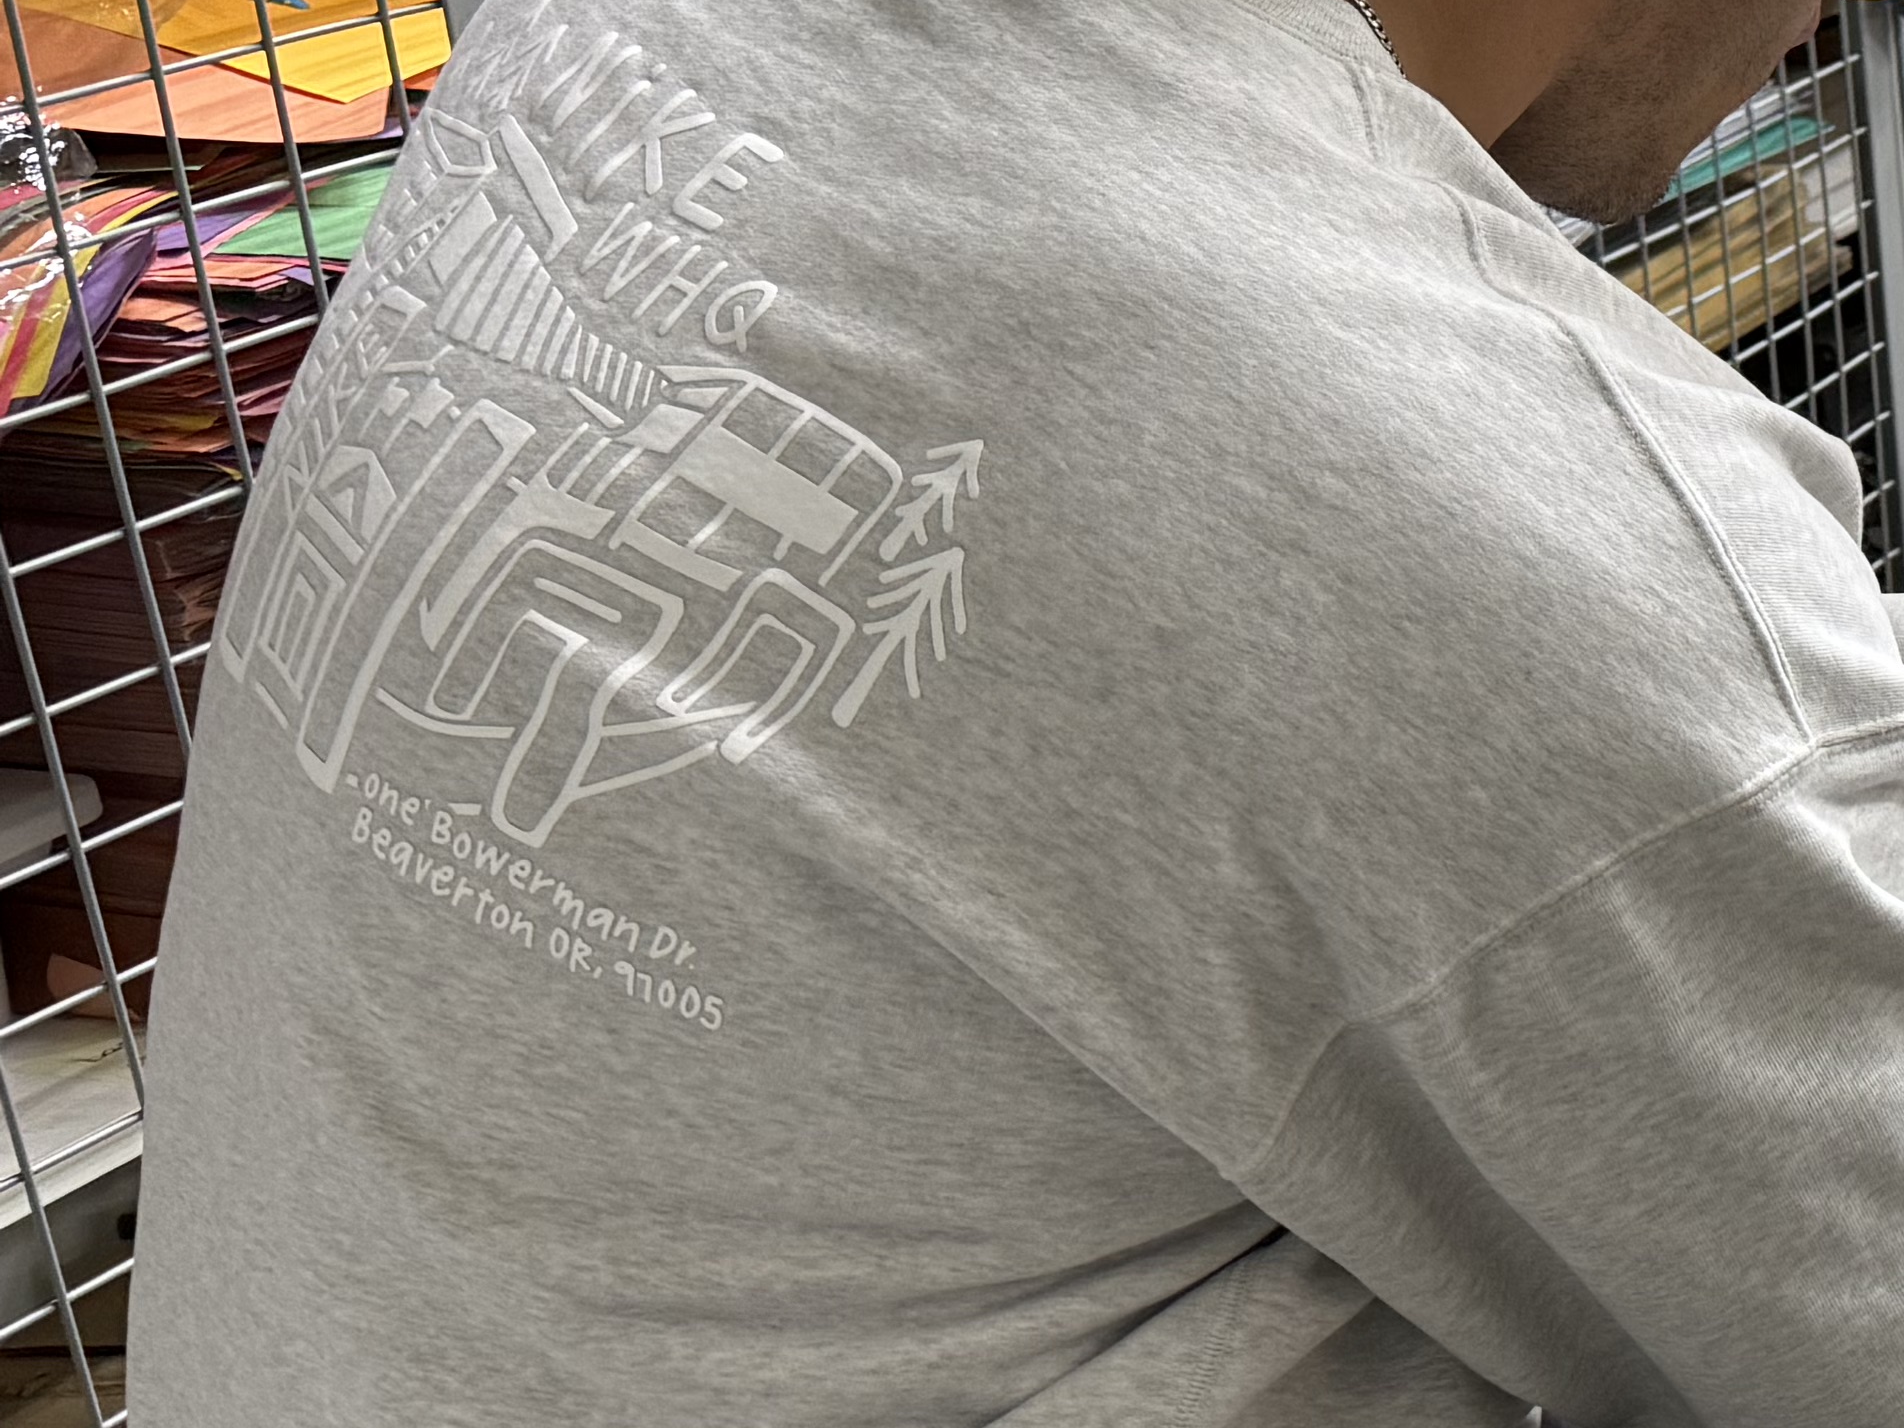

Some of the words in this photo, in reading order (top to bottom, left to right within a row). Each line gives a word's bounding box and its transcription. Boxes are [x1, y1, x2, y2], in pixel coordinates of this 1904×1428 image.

[538, 29, 784, 231] NIKE
[583, 202, 779, 353] WHQ
[351, 806, 534, 949] Beaverton
[549, 927, 603, 979] OR,
[613, 960, 724, 1031] 97005
[431, 810, 640, 953] Bowerman
[649, 926, 697, 970] Dr.
